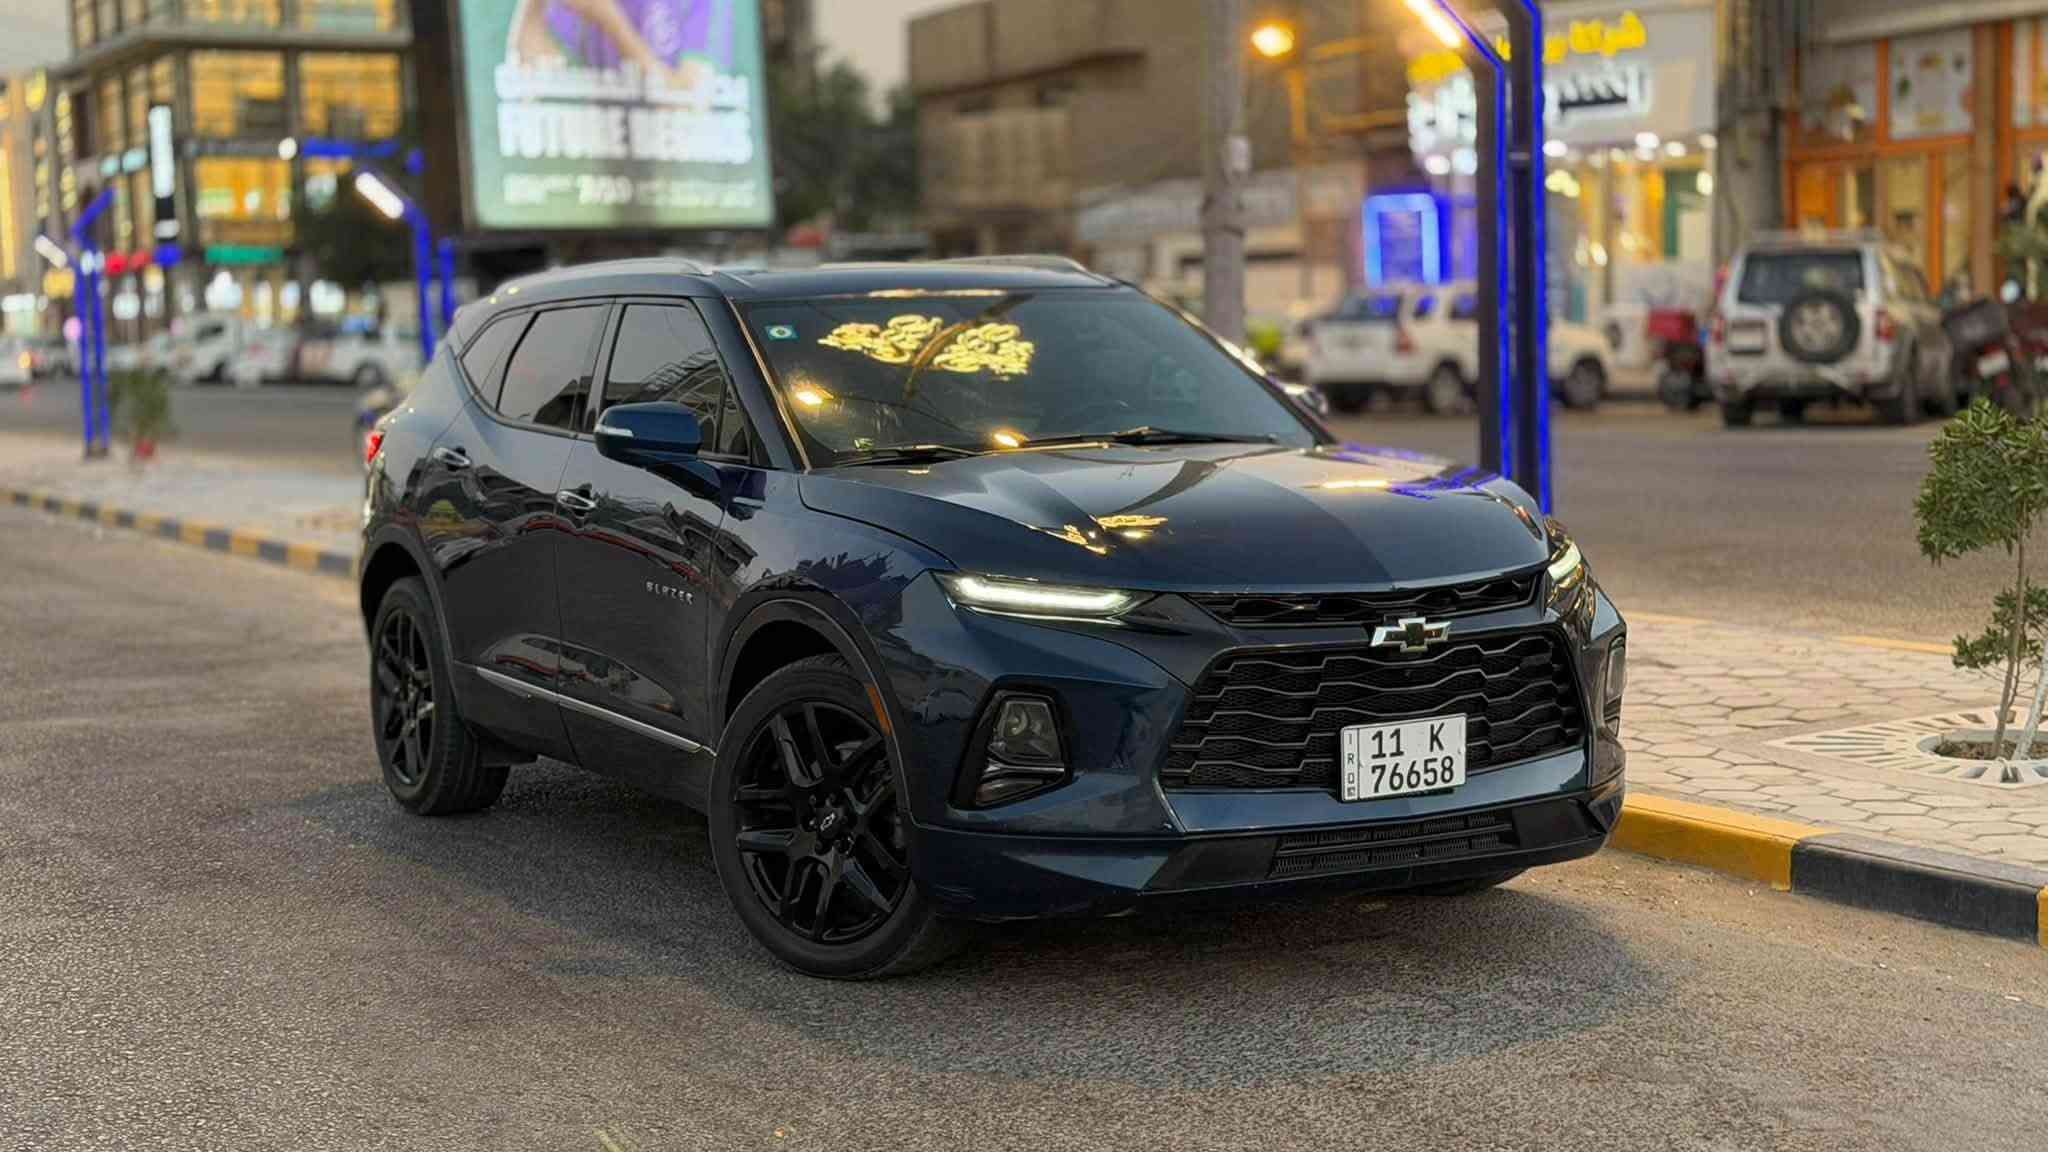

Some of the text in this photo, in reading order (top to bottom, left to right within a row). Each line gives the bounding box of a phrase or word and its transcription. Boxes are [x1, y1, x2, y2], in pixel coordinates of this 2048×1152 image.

[646, 581, 693, 605] BLAZER
[1371, 722, 1445, 759] 11 K
[1371, 755, 1454, 793] 76658
